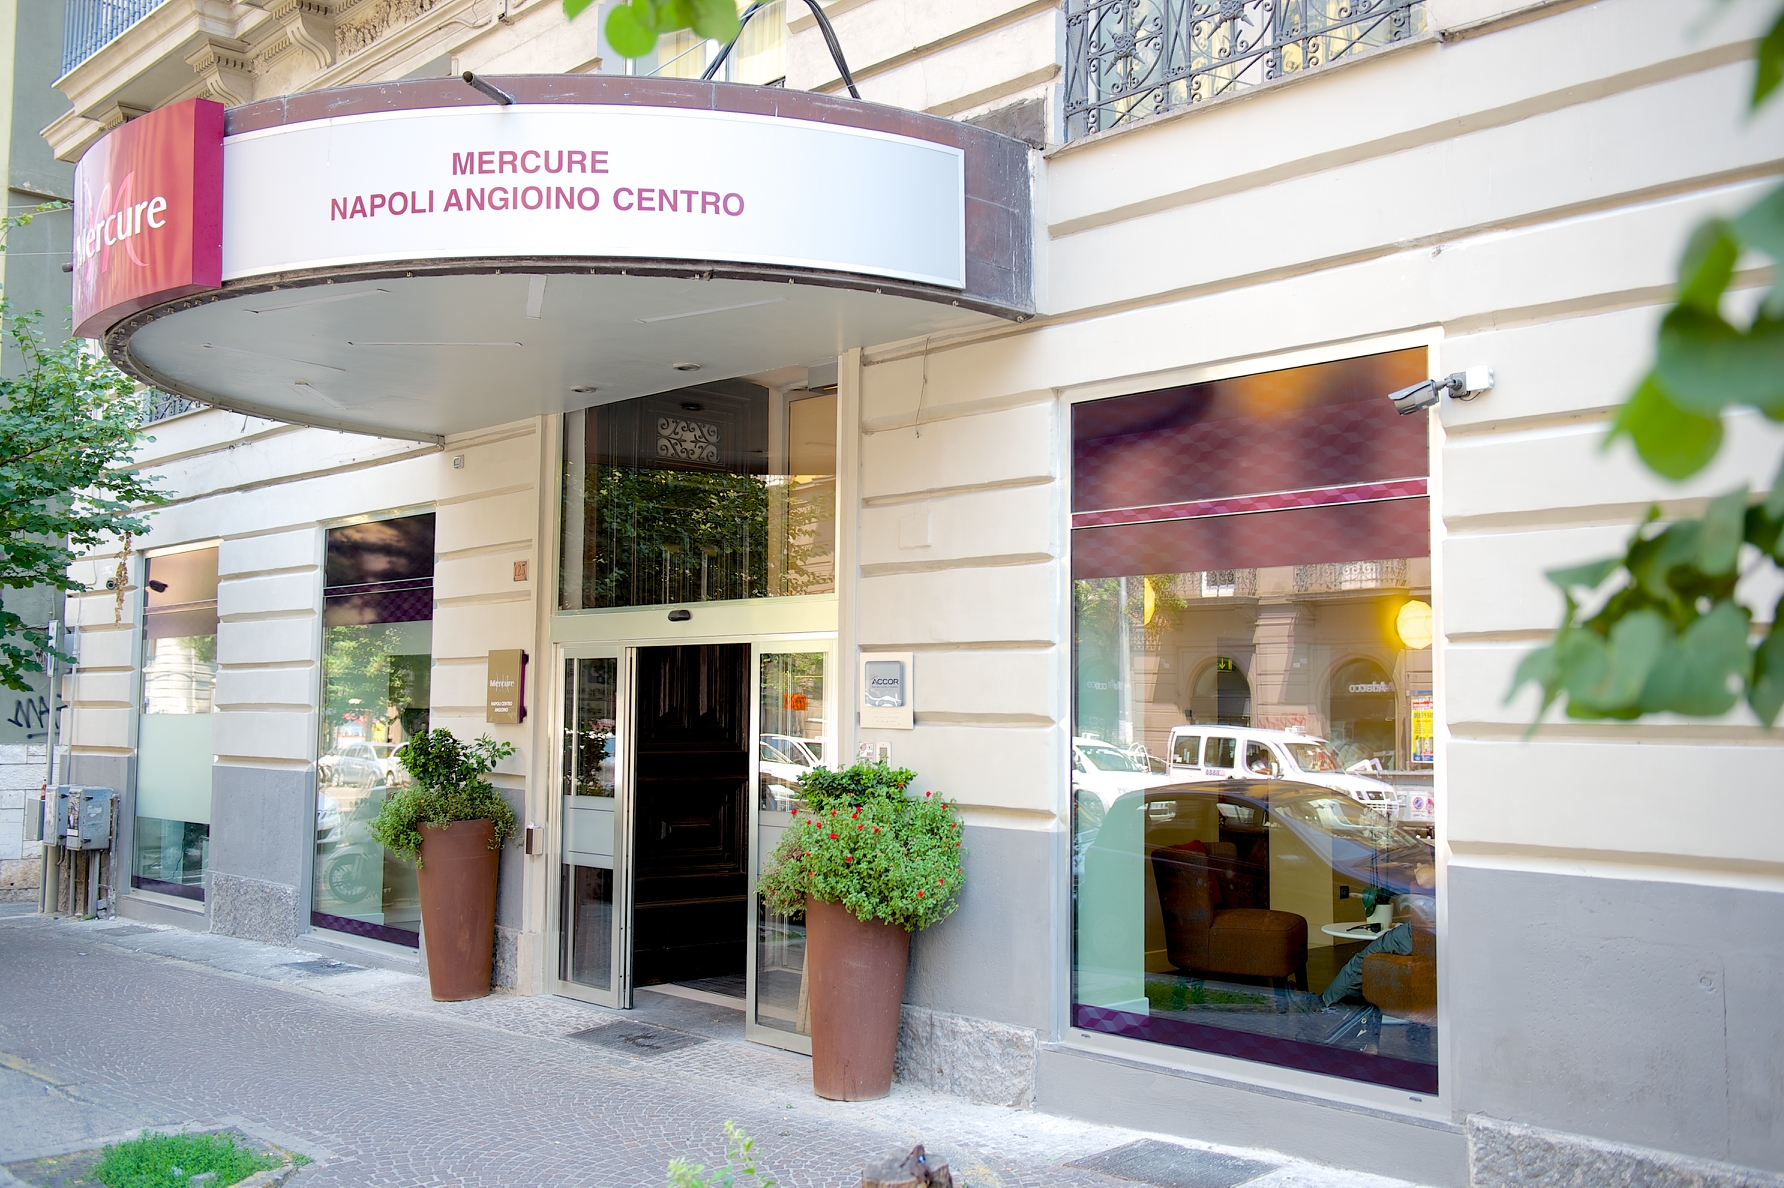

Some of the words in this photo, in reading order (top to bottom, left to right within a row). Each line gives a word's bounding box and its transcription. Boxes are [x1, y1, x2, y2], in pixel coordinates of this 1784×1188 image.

[452, 150, 609, 175] MERCURE
[331, 190, 434, 221] NAPOLI
[443, 186, 600, 212] ANGIOINO
[613, 187, 745, 217] CENTRO
[76, 196, 167, 271] Mercure
[489, 679, 515, 688] Mercure
[871, 678, 900, 686] ACCOR
